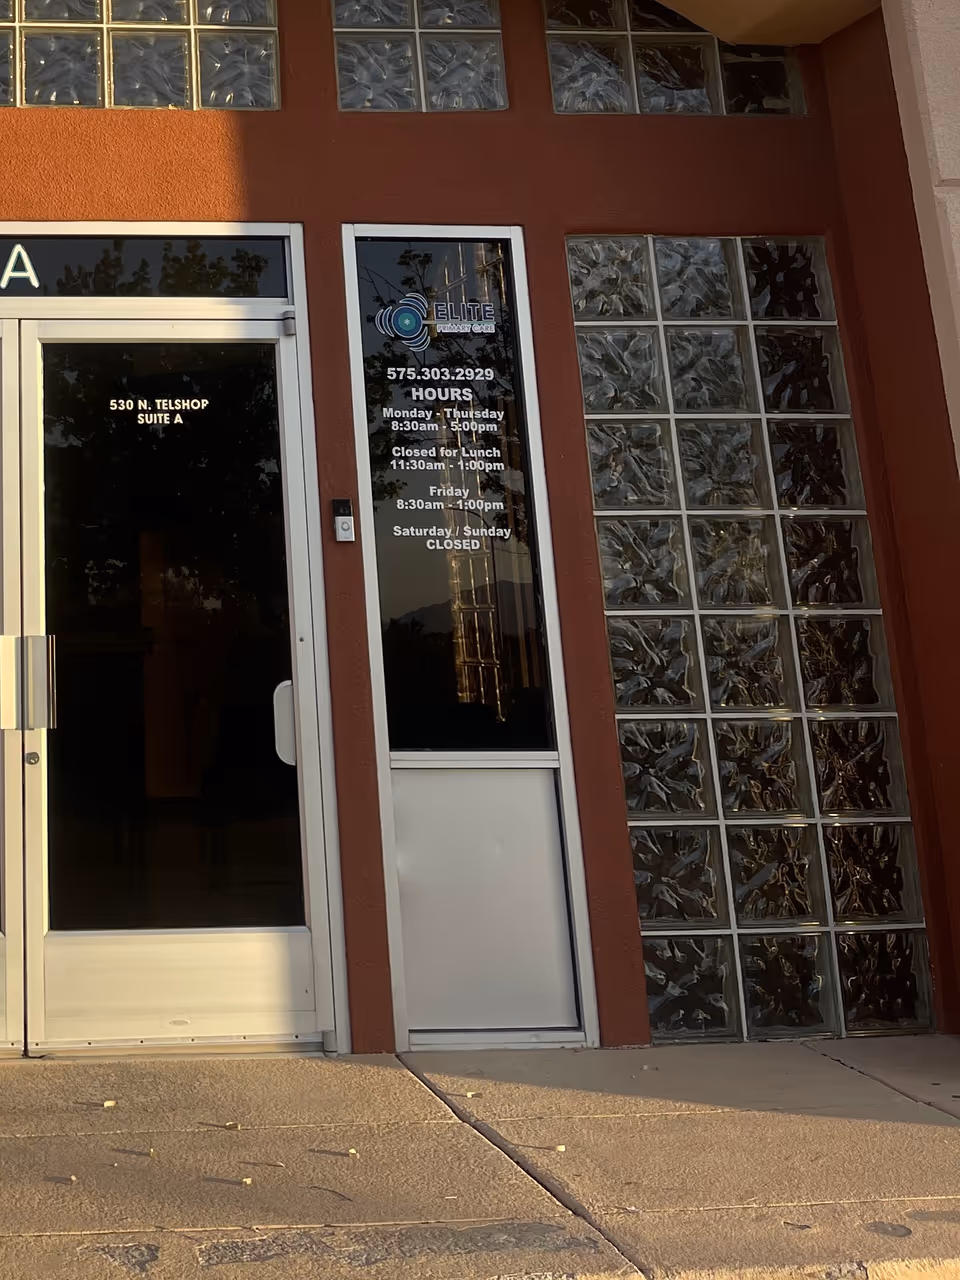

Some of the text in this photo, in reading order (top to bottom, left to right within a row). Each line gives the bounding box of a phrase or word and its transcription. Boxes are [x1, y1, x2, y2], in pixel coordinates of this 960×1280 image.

[0, 244, 40, 289] A
[434, 302, 495, 321] ELITE
[437, 324, 495, 333] PRIMARY CARE
[387, 367, 495, 380] 575.303.2929
[411, 387, 473, 401] HOURS
[109, 399, 134, 410] 530
[138, 399, 151, 410] N.
[137, 413, 184, 424] SUITE A
[382, 407, 433, 420] Monday
[444, 408, 505, 420] Thursday
[391, 421, 439, 431] 8:30am
[450, 421, 498, 433] 5:00pm
[392, 446, 501, 457] Closed for Lunch
[390, 459, 445, 470] 11:30am
[458, 460, 505, 472] 1:00pm
[429, 486, 470, 499] Friday
[396, 499, 445, 510] 8:30am
[456, 499, 504, 512] 1:00pm
[393, 525, 452, 538] Saturday
[463, 526, 511, 539] Sunday
[426, 539, 480, 550] CLOSED
